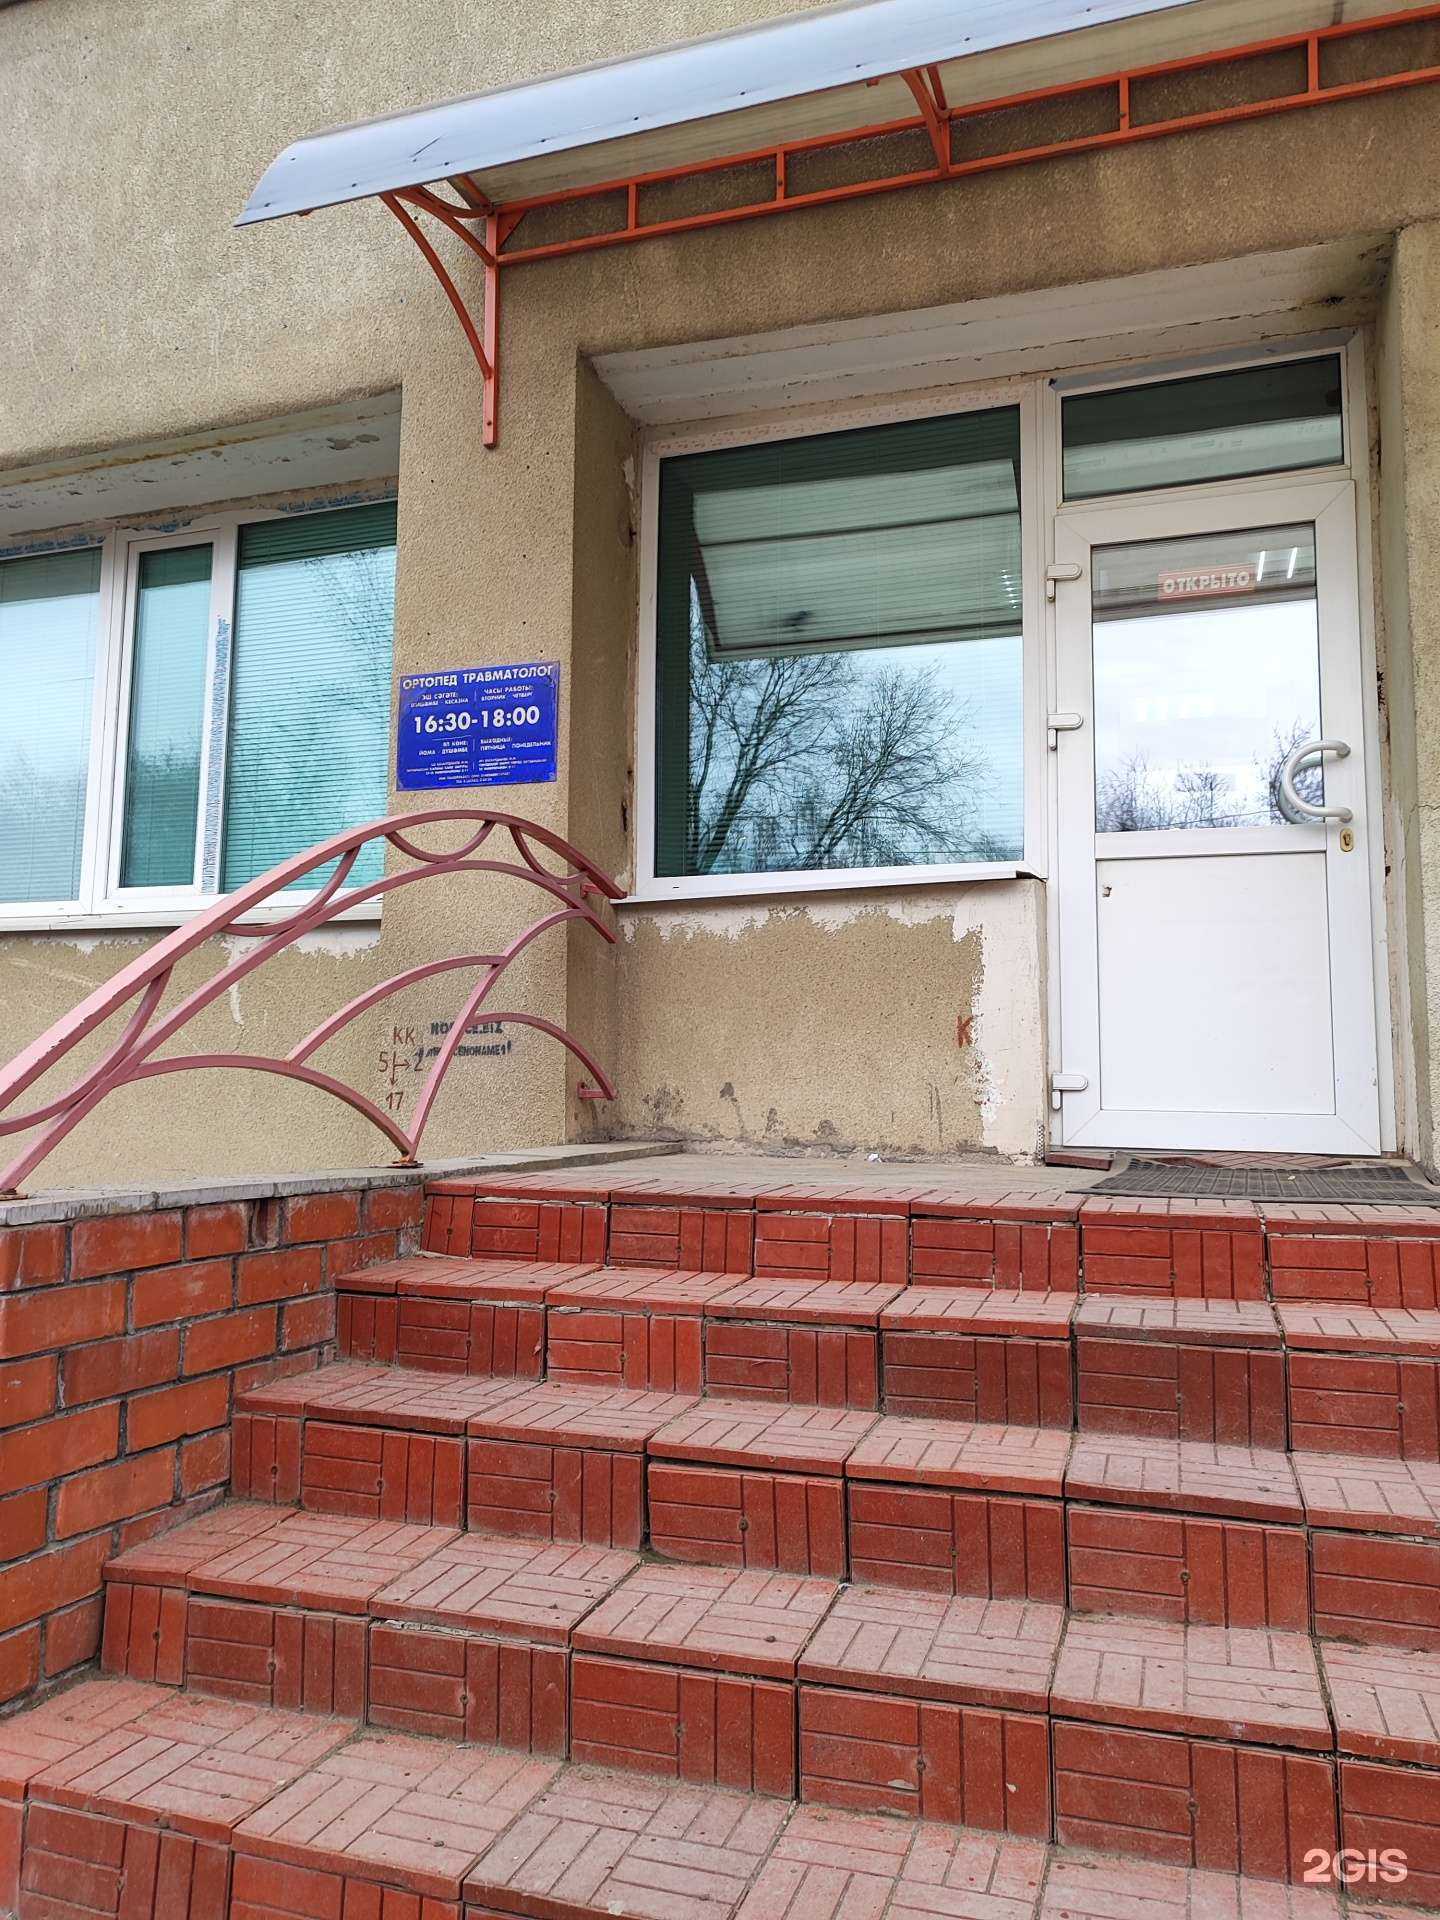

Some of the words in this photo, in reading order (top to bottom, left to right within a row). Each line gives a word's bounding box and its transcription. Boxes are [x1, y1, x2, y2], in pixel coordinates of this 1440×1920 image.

[1163, 571, 1250, 594] ОТКРЫТО
[402, 674, 458, 690] ОРТОПЕД
[463, 665, 553, 684] ТРАВМАТОЛОГ
[484, 687, 503, 695] ЧАСЫ
[414, 705, 540, 734] 16:30-18:00
[386, 1092, 404, 1110] 17
